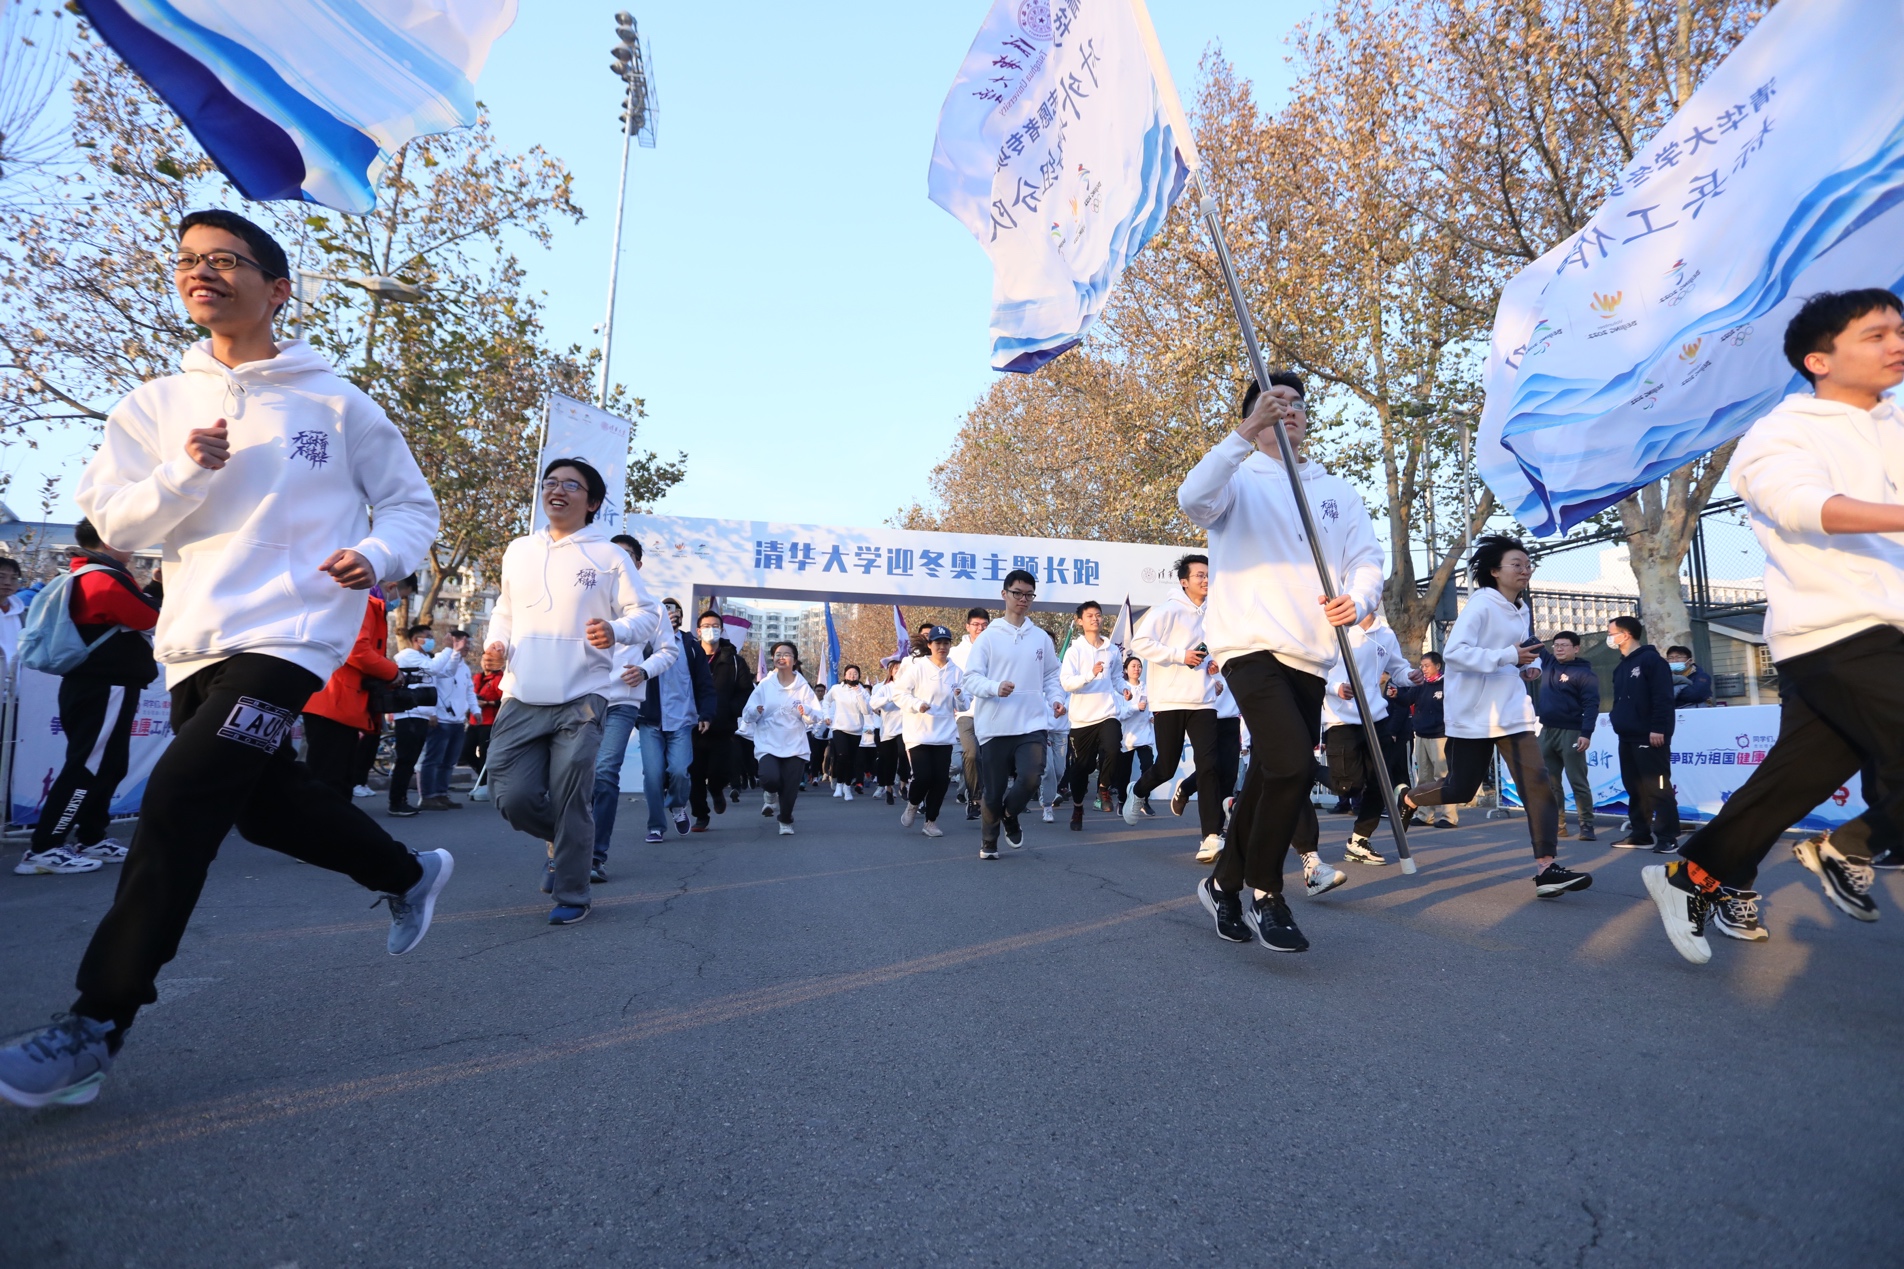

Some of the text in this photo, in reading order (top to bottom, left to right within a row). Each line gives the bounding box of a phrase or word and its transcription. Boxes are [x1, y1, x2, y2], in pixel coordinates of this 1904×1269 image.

[754, 540, 1100, 586] 清华大学迎冬奥主题长跑
[1670, 750, 1766, 766] 争取为祖国健康
[51, 788, 87, 835] BASKETBALL
